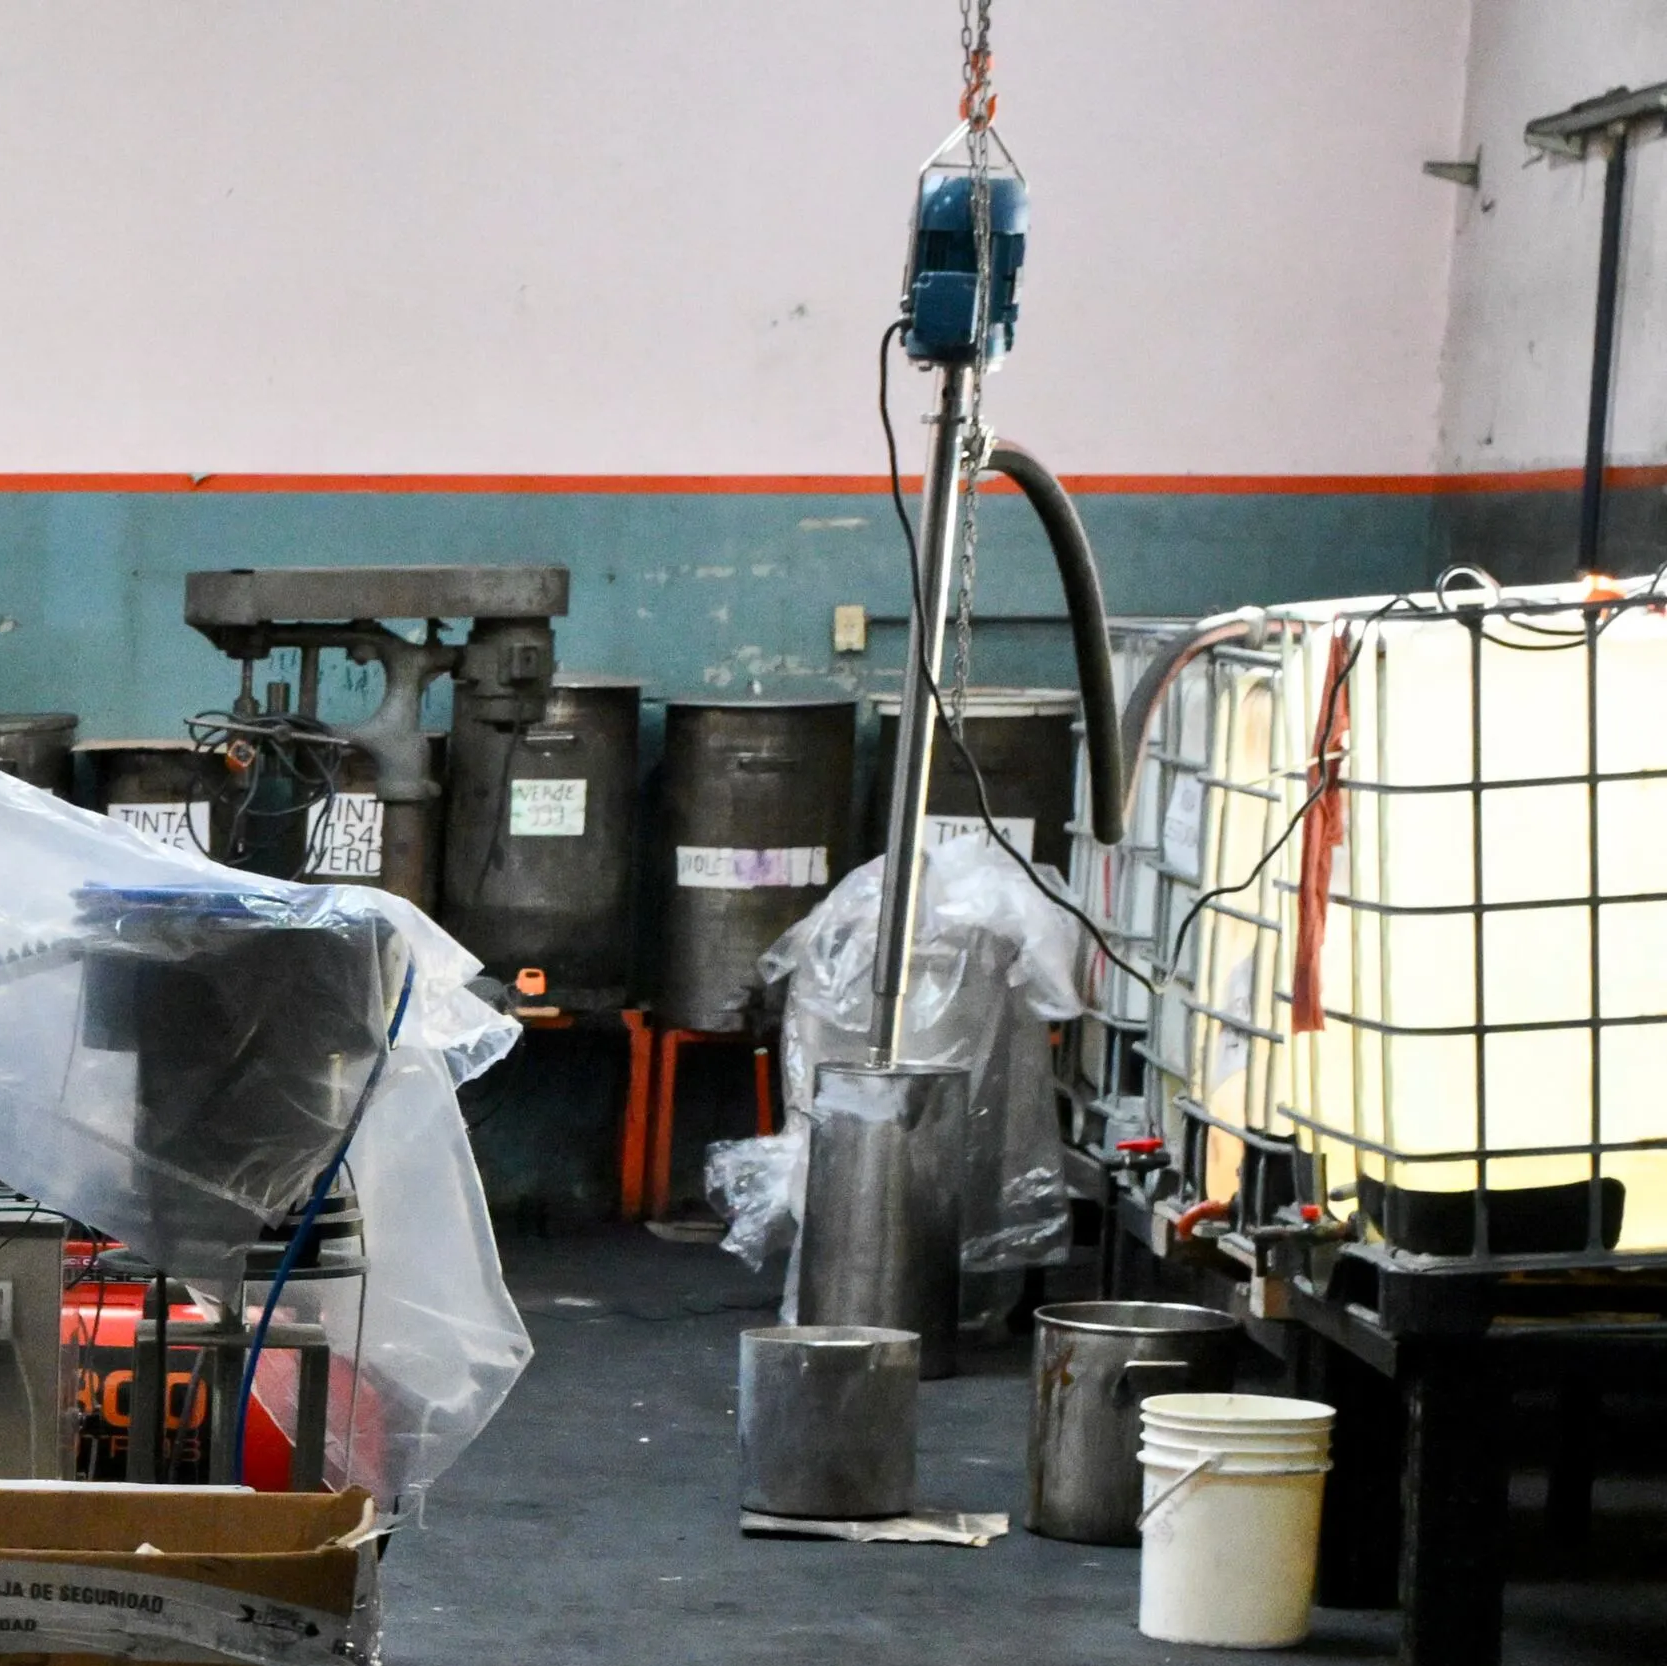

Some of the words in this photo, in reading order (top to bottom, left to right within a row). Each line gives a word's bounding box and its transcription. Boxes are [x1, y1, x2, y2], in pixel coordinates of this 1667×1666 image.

[120, 808, 192, 834] TINTA
[29, 1580, 53, 1601] DE
[58, 1582, 165, 1614] SEGURIDAD
